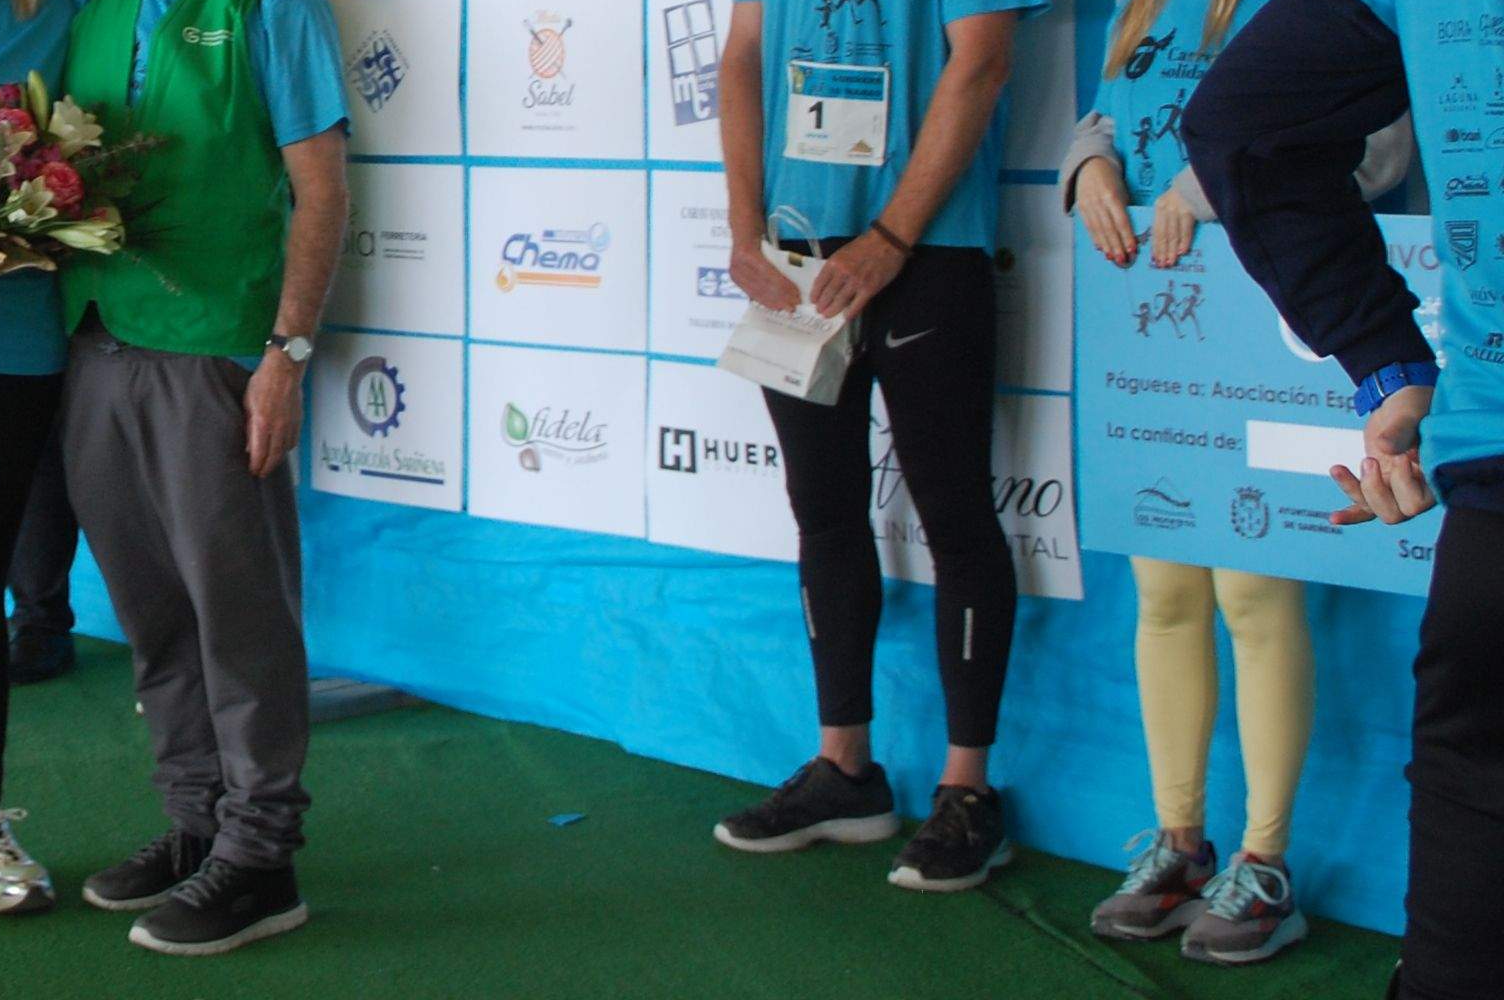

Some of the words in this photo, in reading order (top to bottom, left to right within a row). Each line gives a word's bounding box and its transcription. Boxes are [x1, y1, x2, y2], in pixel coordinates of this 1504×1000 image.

[808, 101, 824, 129] 1
[501, 232, 600, 271] Chema
[1106, 371, 1182, 396] Páguese
[1188, 382, 1206, 397] a:
[1212, 381, 1320, 407] Asociación
[1107, 423, 1125, 440] La
[1131, 423, 1208, 448] cantidad
[1213, 432, 1243, 450] de:
